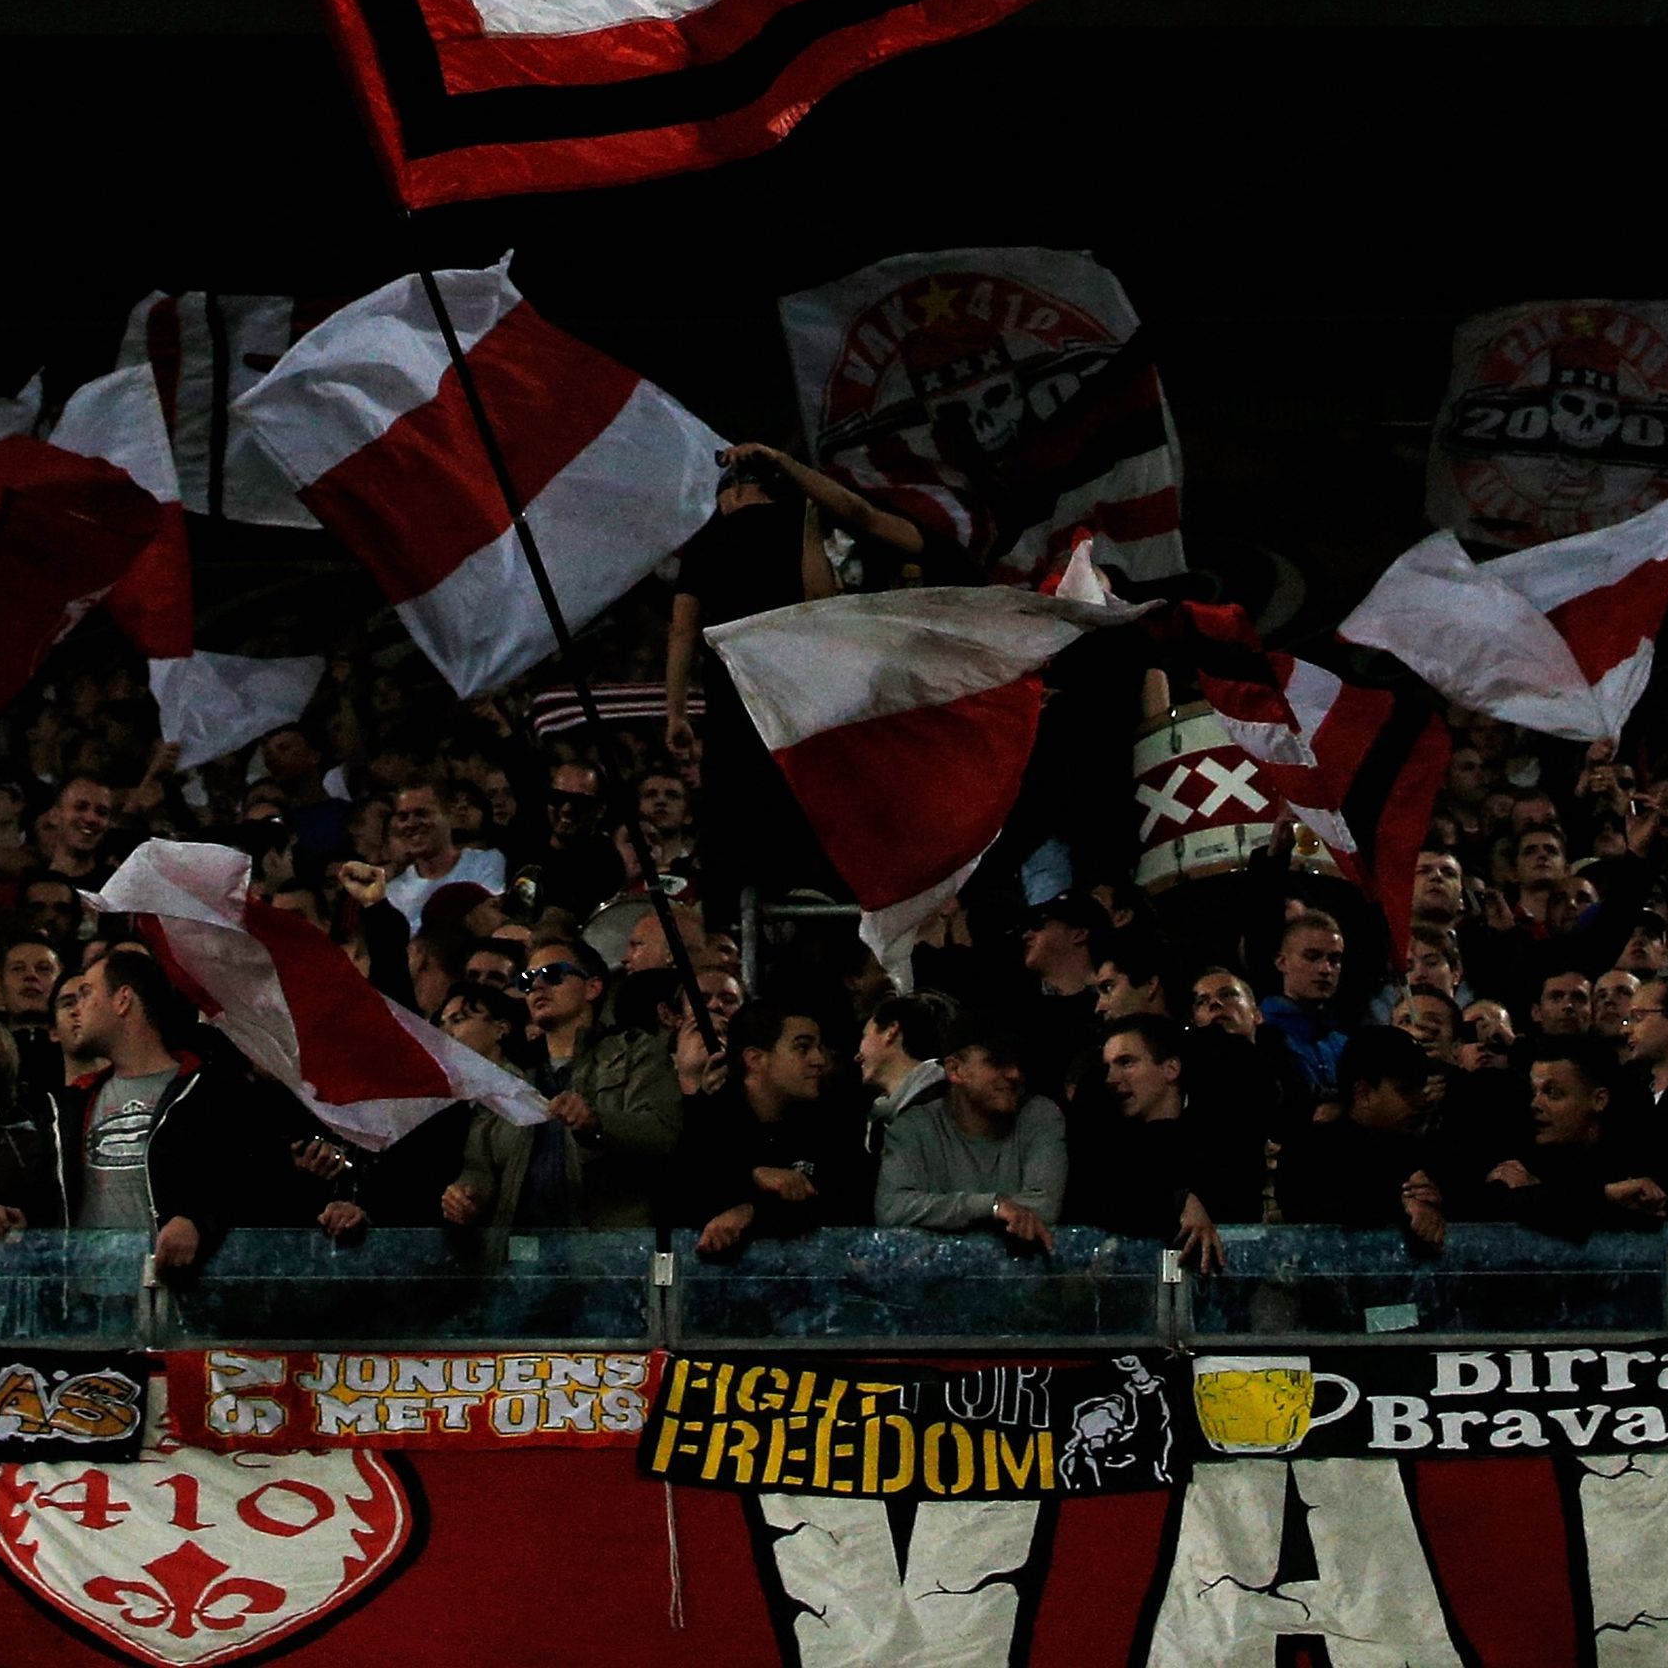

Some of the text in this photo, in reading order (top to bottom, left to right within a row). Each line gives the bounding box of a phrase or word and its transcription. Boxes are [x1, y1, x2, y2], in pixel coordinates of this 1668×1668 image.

[295, 1351, 648, 1394] JONGENS
[666, 1358, 902, 1418] FIGHT
[314, 1387, 648, 1438] MET ONS
[651, 1413, 1057, 1495] FREEDOM
[34, 1468, 335, 1538] 410
